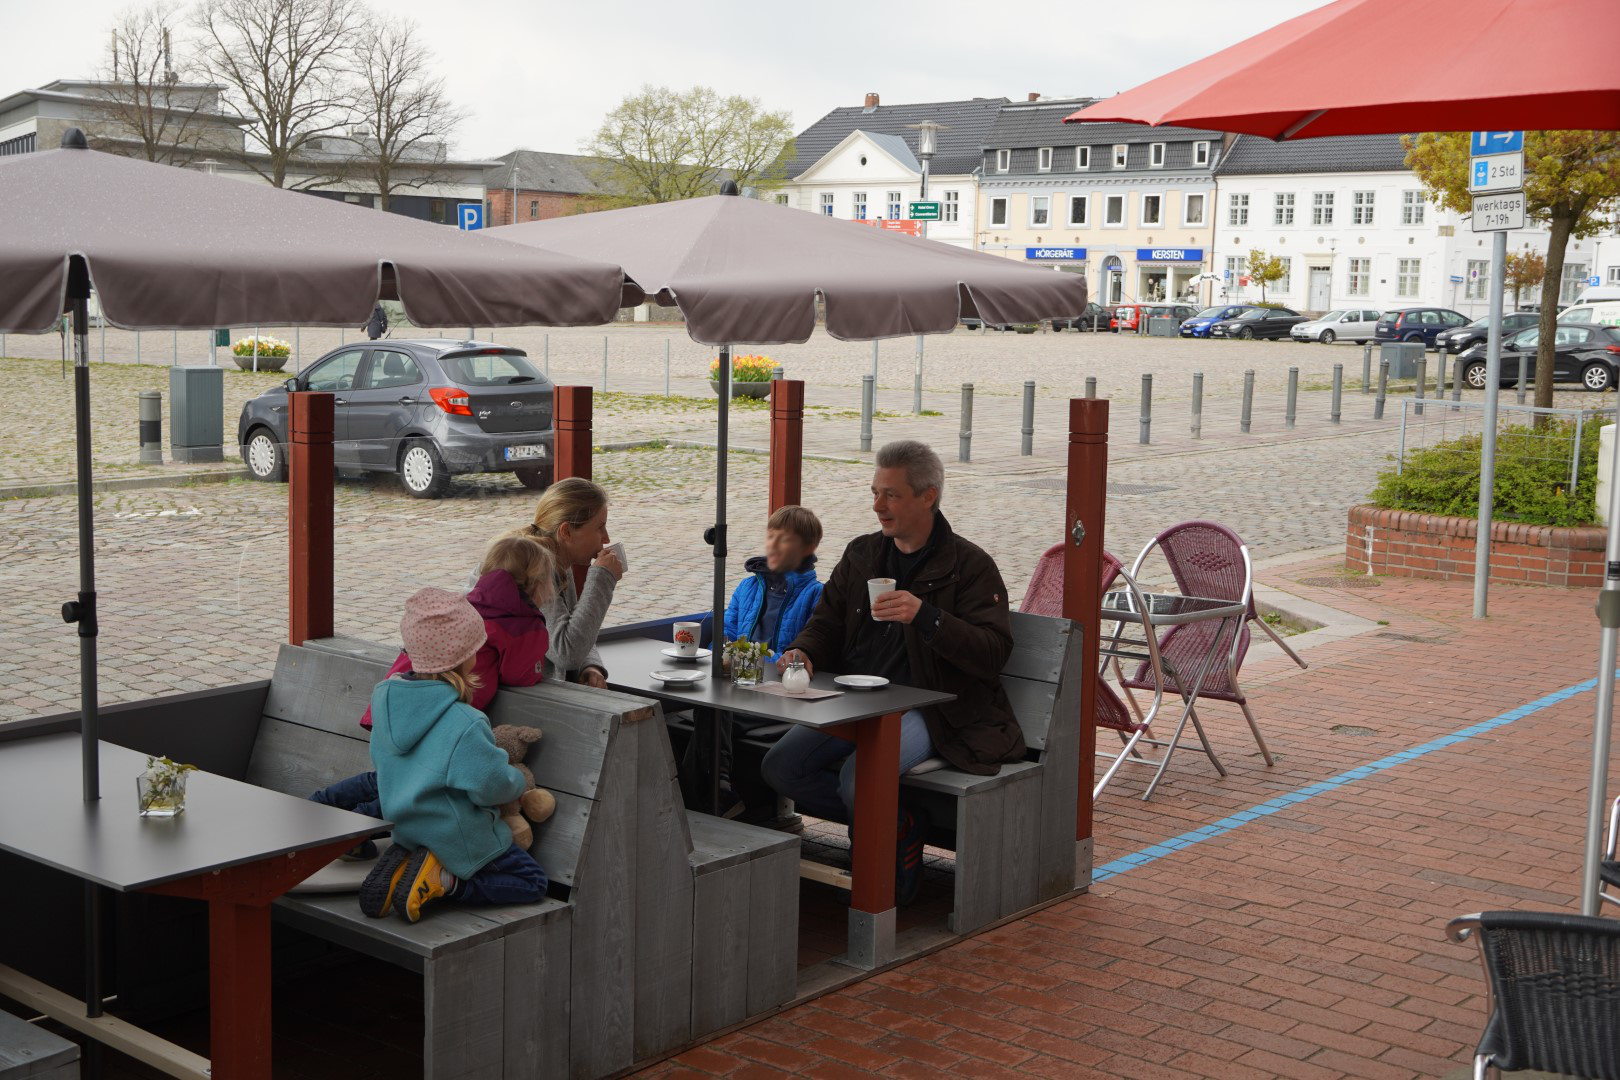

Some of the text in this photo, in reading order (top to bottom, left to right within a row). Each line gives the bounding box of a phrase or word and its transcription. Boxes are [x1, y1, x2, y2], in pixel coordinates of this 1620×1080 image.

[1491, 165, 1517, 178] 2 Std.
[1476, 199, 1521, 212] werktags
[464, 208, 478, 231] P
[1486, 213, 1510, 226] 7-19h
[1035, 248, 1074, 259] HÖRGERÄTE
[1151, 249, 1184, 260] KERSTEN
